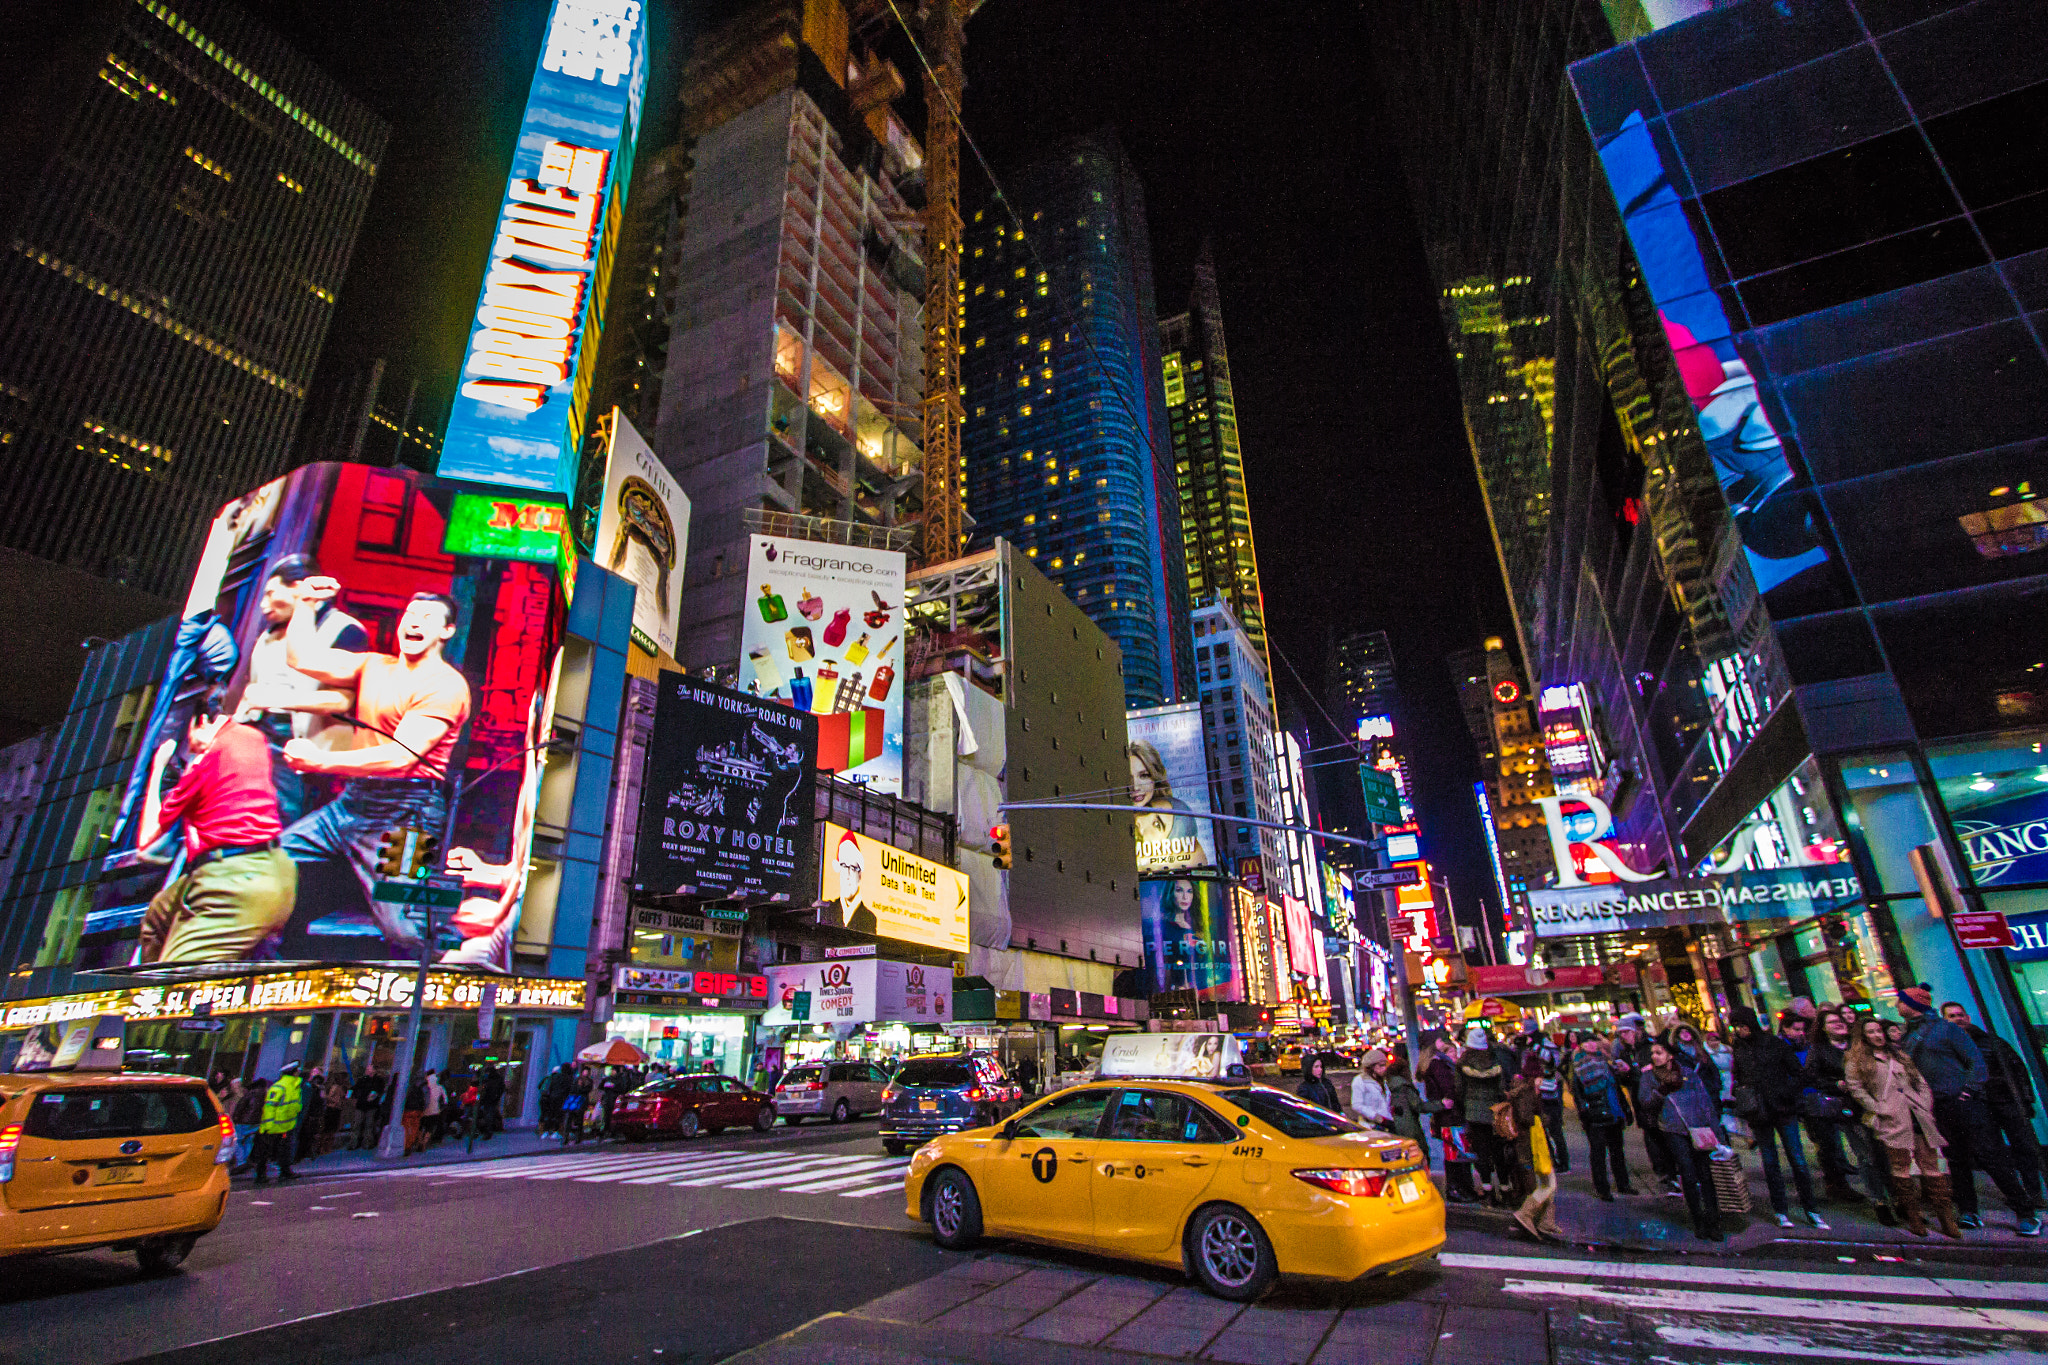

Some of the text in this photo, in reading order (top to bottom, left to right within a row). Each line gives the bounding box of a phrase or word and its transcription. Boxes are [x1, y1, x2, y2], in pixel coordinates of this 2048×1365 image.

[495, 178, 598, 266] TALE
[467, 256, 585, 386] BRONX
[461, 380, 545, 412] A
[782, 550, 897, 577] Fragrance.com
[693, 688, 715, 706] NEW
[718, 695, 742, 715] YORK
[758, 707, 786, 727] ROARS
[789, 717, 802, 731] ON
[723, 764, 757, 780] ROXY
[663, 816, 795, 857] ROXY HOTEL
[881, 850, 936, 886] Unlimited
[1364, 871, 1413, 884] ONE WAY
[403, 887, 439, 903] 7 AV
[881, 874, 936, 901] Data Talk Text
[1532, 890, 1688, 924] RENAISSANCE
[638, 911, 661, 927] GIFTS
[668, 913, 704, 931] LUGGAGE
[1255, 902, 1271, 979] PALACE
[694, 971, 768, 997] GIFTS
[820, 963, 851, 988] LOL
[906, 966, 925, 988] LOL
[164, 991, 184, 1012] SL
[250, 979, 313, 1006] RETAIL
[423, 984, 447, 1001] SL
[454, 985, 514, 1003] GRN
[519, 988, 579, 1007] RETAIL
[821, 996, 852, 1010] COMEDY
[837, 1007, 853, 1016] CLUB
[1112, 1045, 1139, 1057] Crush
[1232, 1145, 1263, 1158] 4H13
[1038, 1153, 1053, 1179] T
